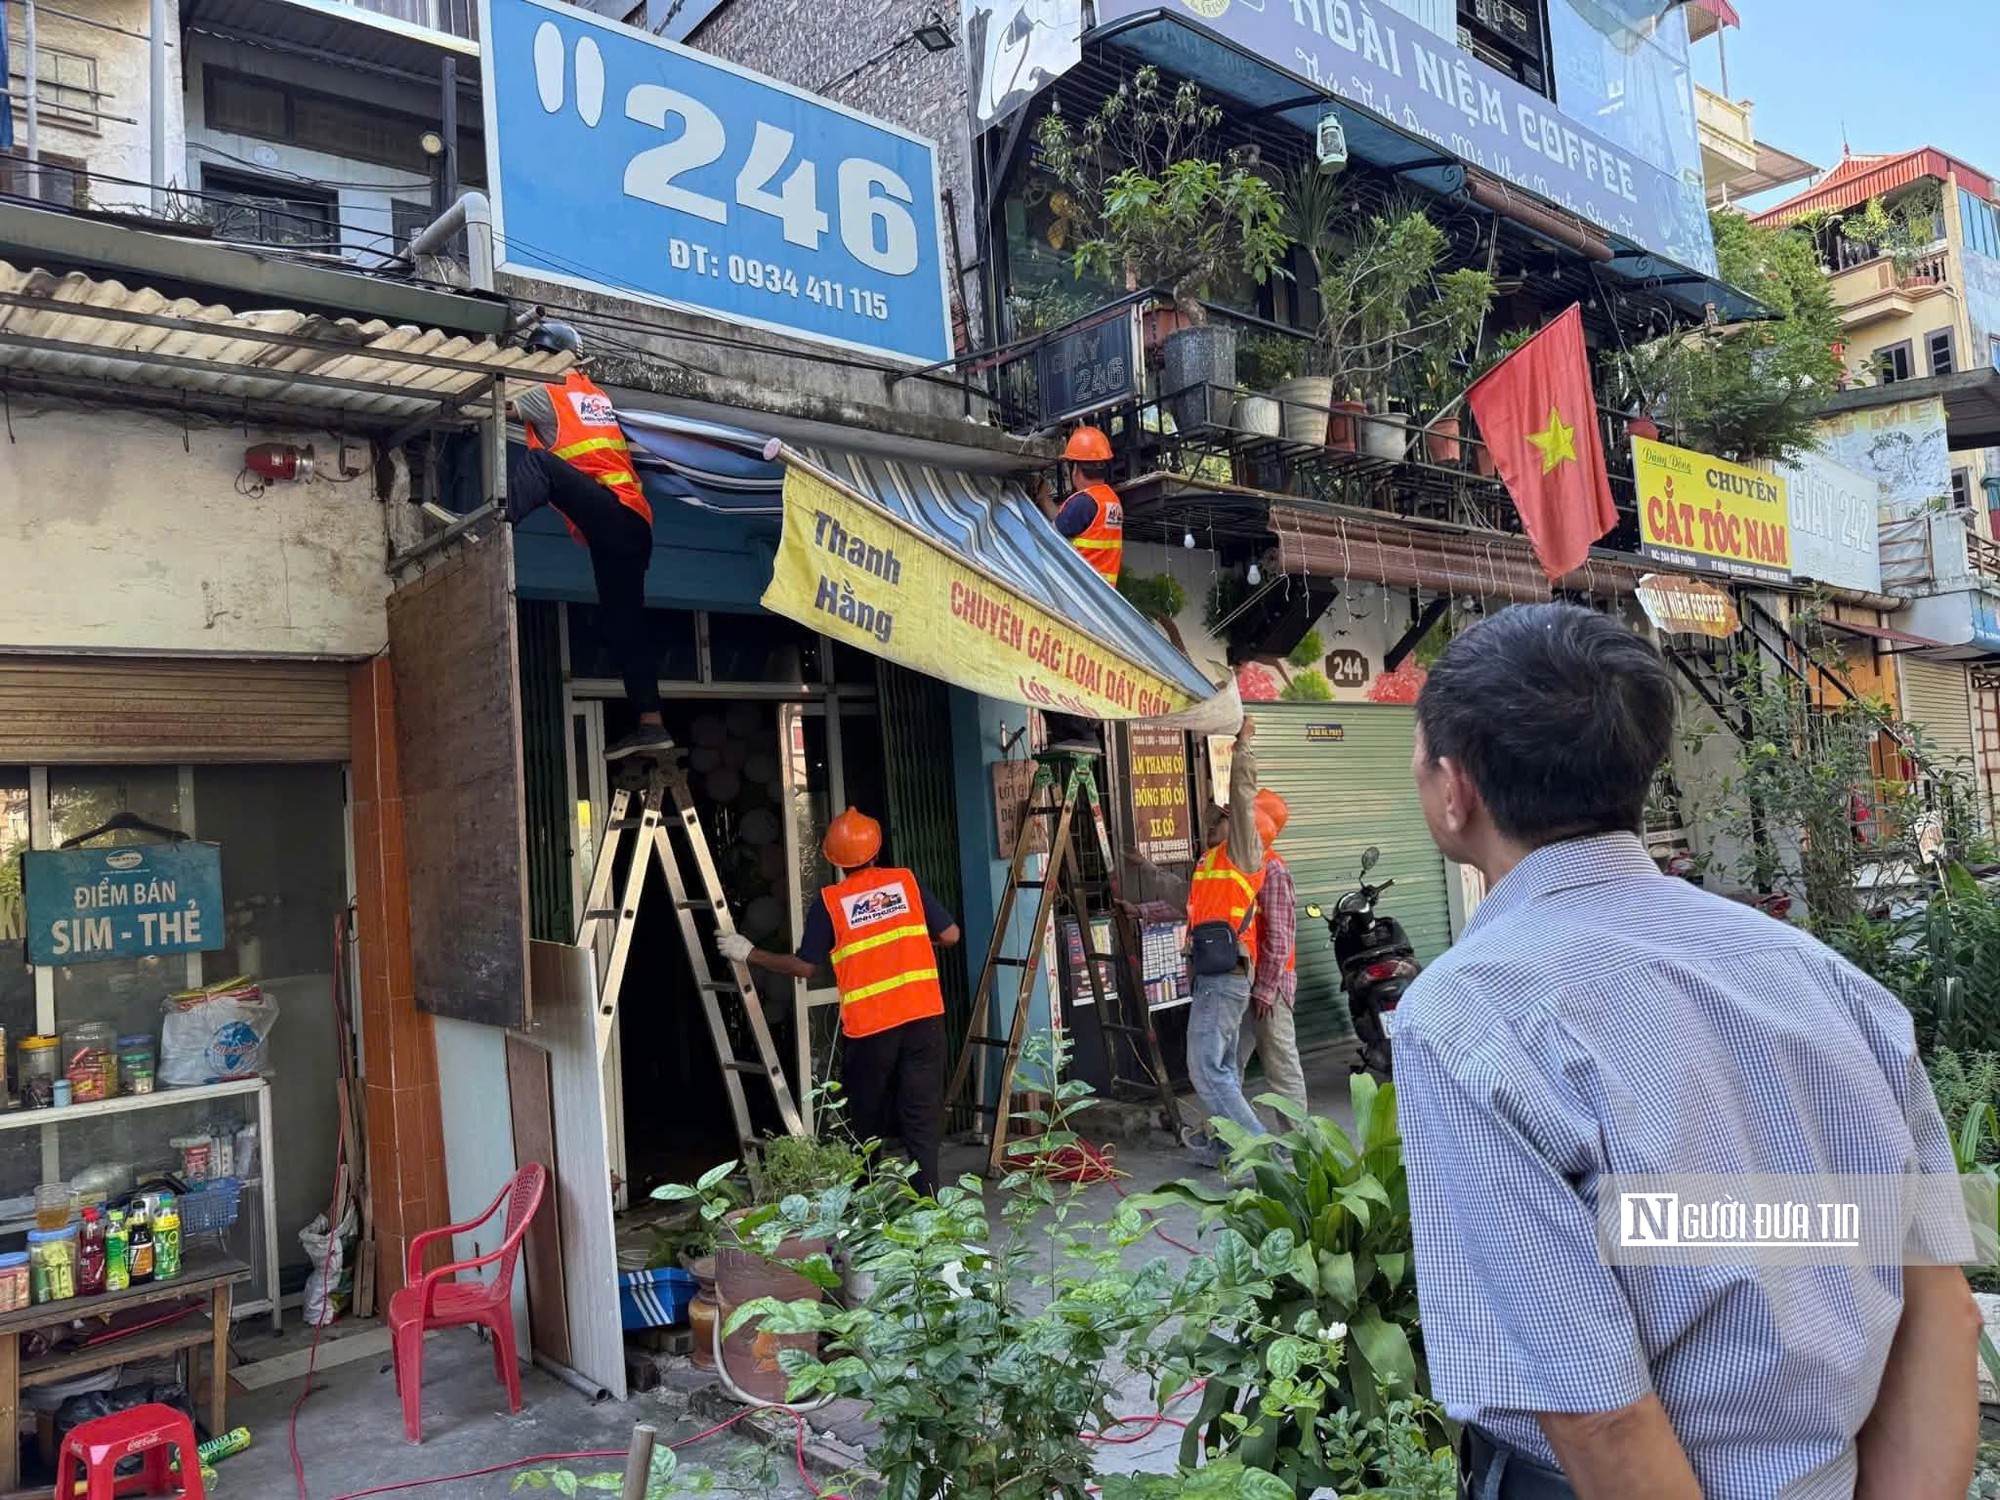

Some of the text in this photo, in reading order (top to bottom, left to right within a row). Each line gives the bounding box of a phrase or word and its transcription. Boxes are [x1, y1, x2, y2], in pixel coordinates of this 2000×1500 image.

[1413, 41, 1509, 136] NIỆM
[1517, 102, 1638, 204] COFFEE
[623, 84, 919, 276] 246
[669, 239, 889, 321] ĐT: 0934 411 115
[1705, 468, 1778, 504] CHUYÊN
[814, 508, 901, 586] Thanh
[1647, 475, 1695, 548] CẮT
[1698, 498, 1742, 556] TÓC
[1743, 517, 1788, 565] NAM
[814, 575, 895, 644] Hằng
[1690, 593, 1727, 623] COFFEE
[950, 580, 1024, 651] CHUYÊN
[1027, 626, 1062, 671] CÁC
[1065, 646, 1102, 696] LOẠI
[1105, 669, 1135, 711] DÂY
[1332, 655, 1364, 681] 244
[1145, 755, 1173, 774] THANH
[1150, 818, 1162, 837] XE
[74, 876, 177, 910] ĐIỂM BÁN
[51, 915, 114, 955] SIM
[138, 899, 203, 946] THẺ
